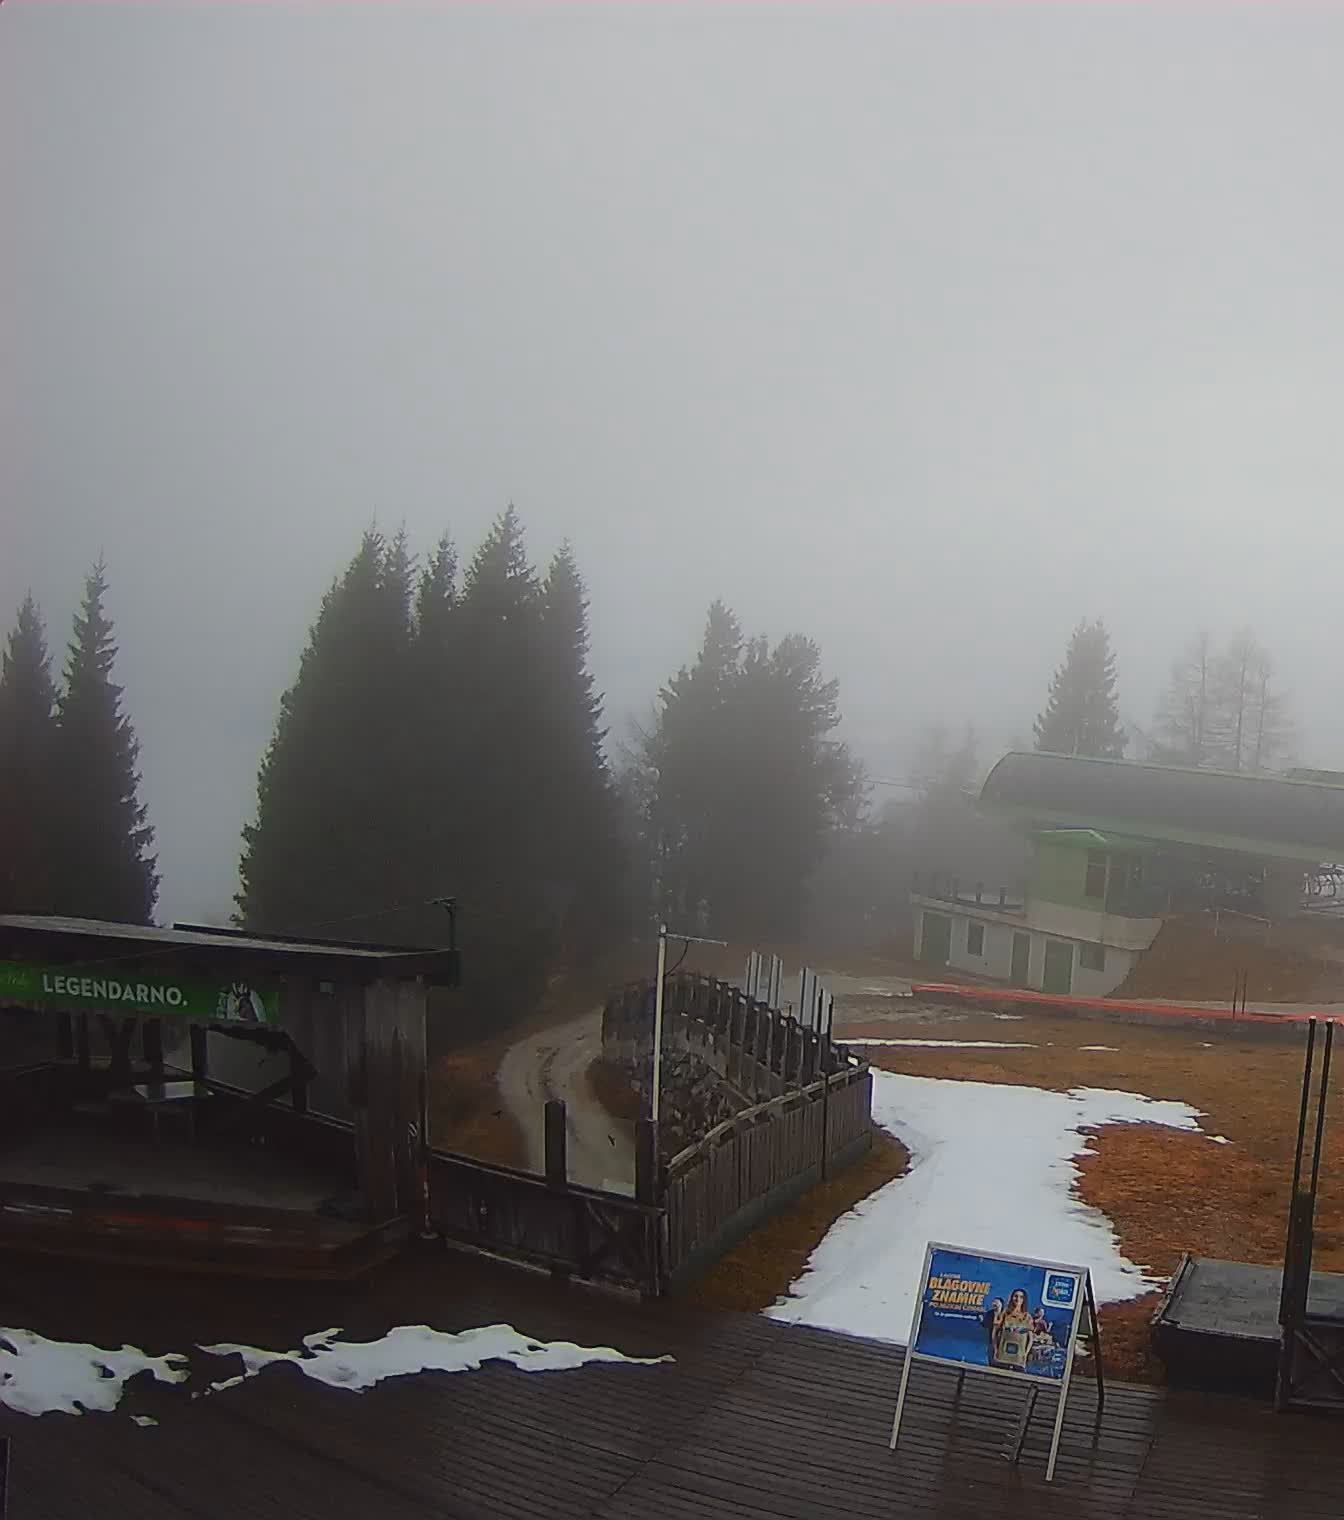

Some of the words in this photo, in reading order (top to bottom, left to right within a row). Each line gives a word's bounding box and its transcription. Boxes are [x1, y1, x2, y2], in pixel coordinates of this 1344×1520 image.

[43, 974, 188, 1006] LEGENDARNO.
[929, 1276, 991, 1295] BLAGOVNE
[932, 1290, 984, 1305] ZNAMKE
